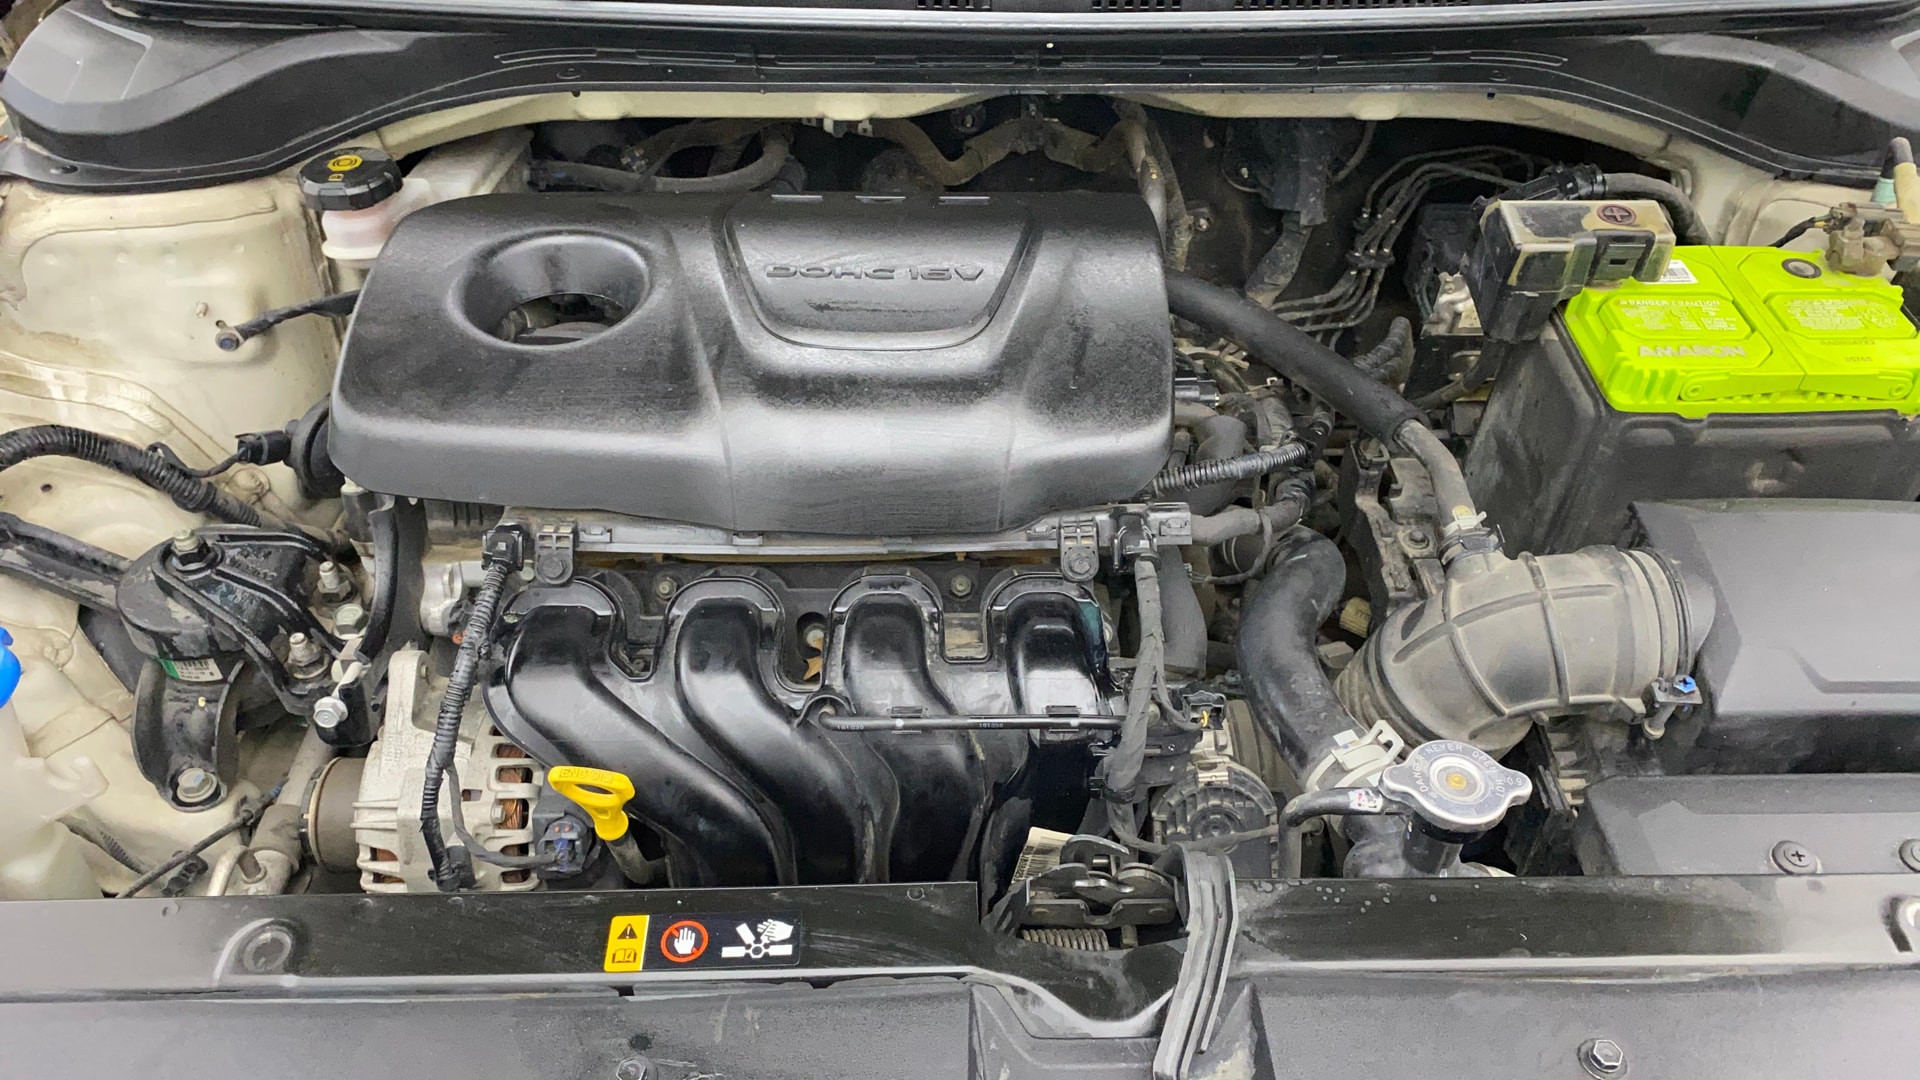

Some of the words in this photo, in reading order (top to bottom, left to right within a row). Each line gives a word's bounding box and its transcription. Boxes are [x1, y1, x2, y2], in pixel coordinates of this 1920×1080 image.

[765, 265, 895, 280] DOHC
[908, 265, 984, 281] 16V
[1639, 344, 1747, 358] AMARON
[1426, 743, 1463, 754] NEVER
[1471, 750, 1498, 773] OPEN
